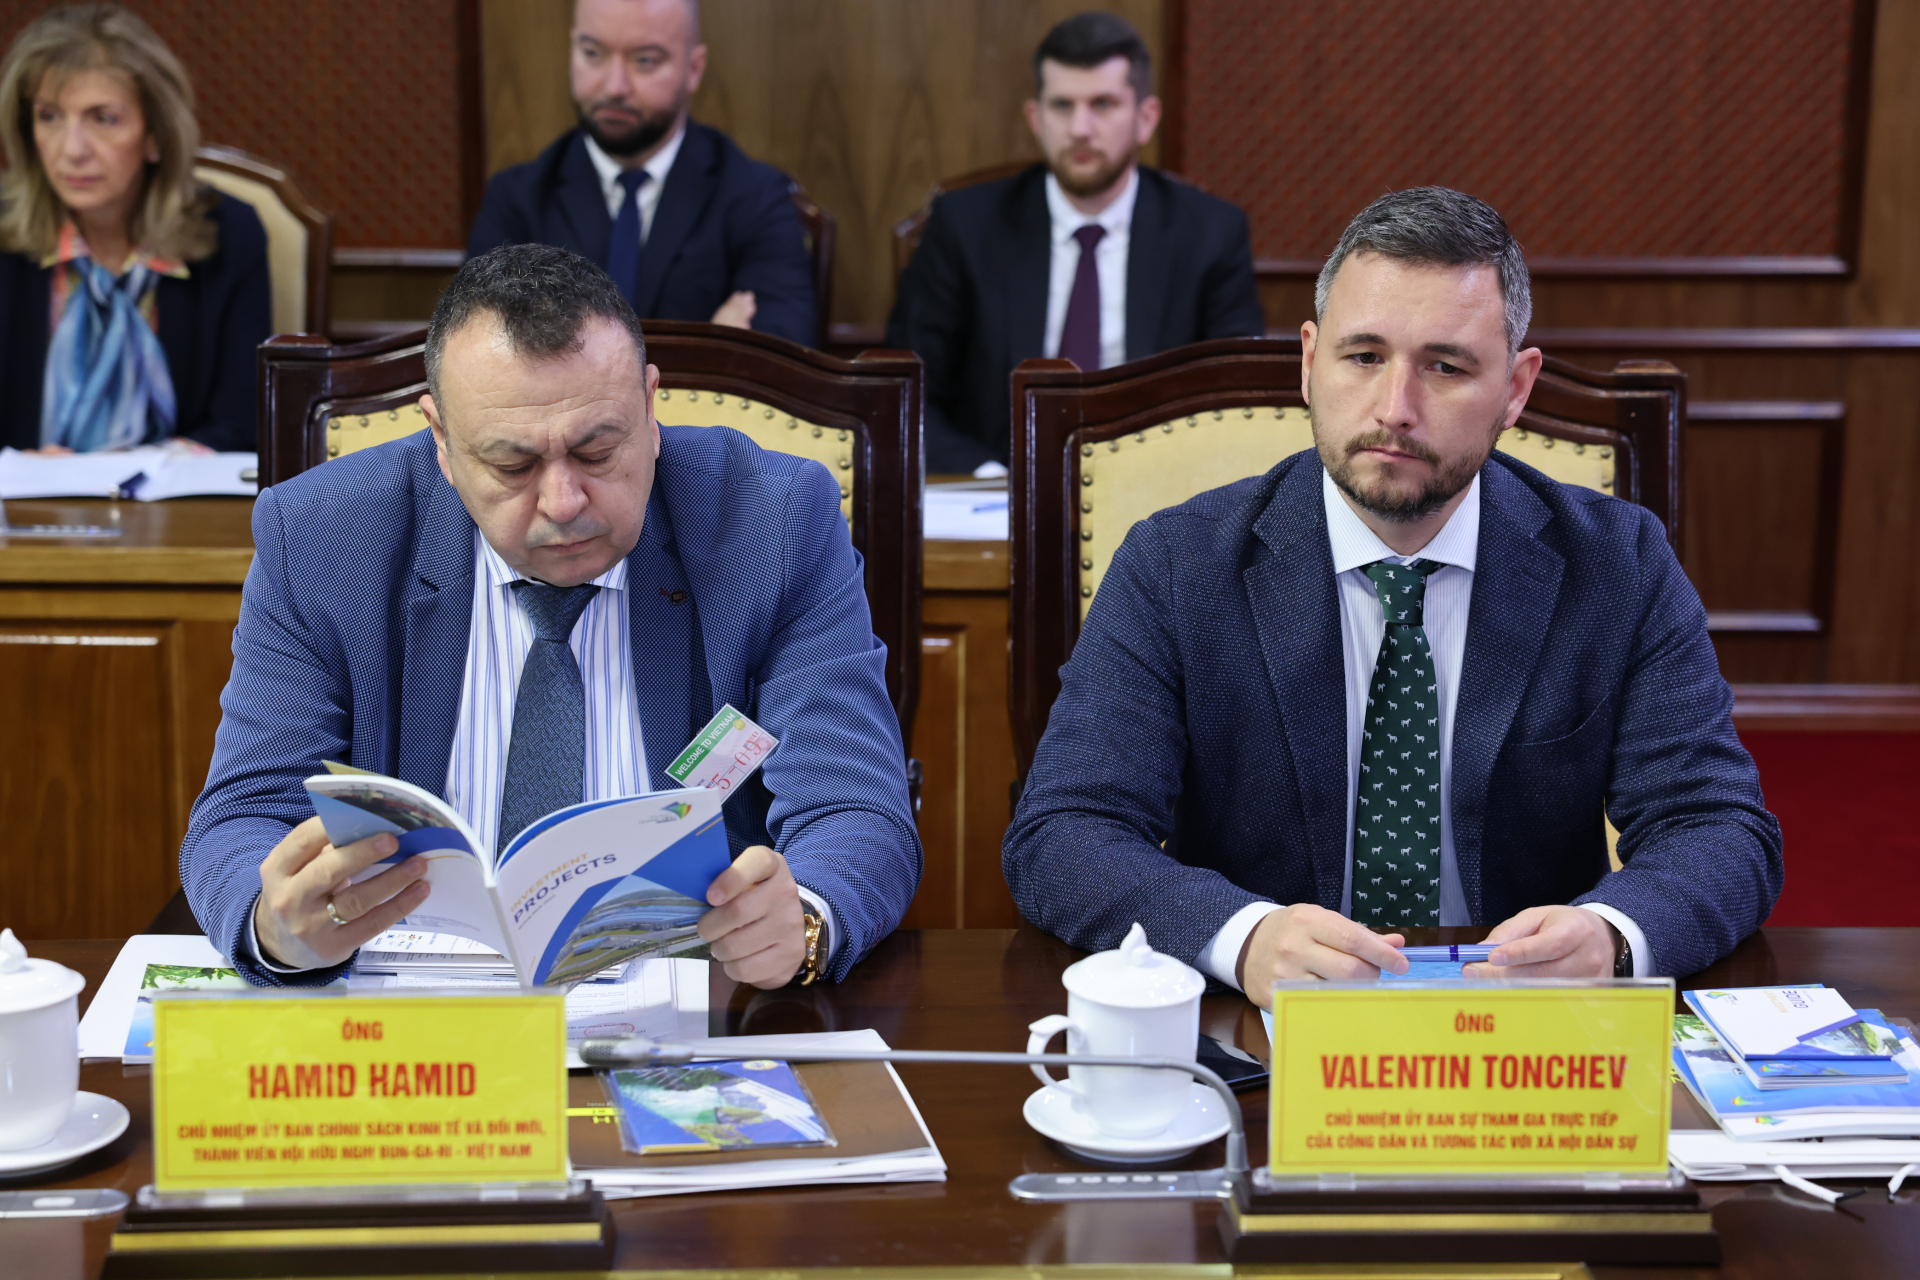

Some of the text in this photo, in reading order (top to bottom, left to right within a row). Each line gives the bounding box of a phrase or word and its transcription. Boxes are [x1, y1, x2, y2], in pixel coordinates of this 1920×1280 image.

[675, 712, 736, 776] WELCOME TO VIETNAM
[511, 853, 588, 912] INVESTMENT
[514, 854, 616, 923] PROJECTS
[1782, 990, 1809, 1008] GUIDE
[342, 1017, 383, 1041] ÔNG
[1455, 1009, 1494, 1034] ÔNG
[249, 1062, 476, 1098] HAMID HAMID
[1320, 1055, 1628, 1089] VALENTIN TONCHEV
[1356, 1109, 1400, 1128] NHIỆM
[1426, 1112, 1454, 1126] BAN
[1482, 1112, 1519, 1126] THAM
[1523, 1112, 1545, 1126] GIA
[1337, 1132, 1374, 1149] CÔNG
[1378, 1132, 1406, 1149] DÂN
